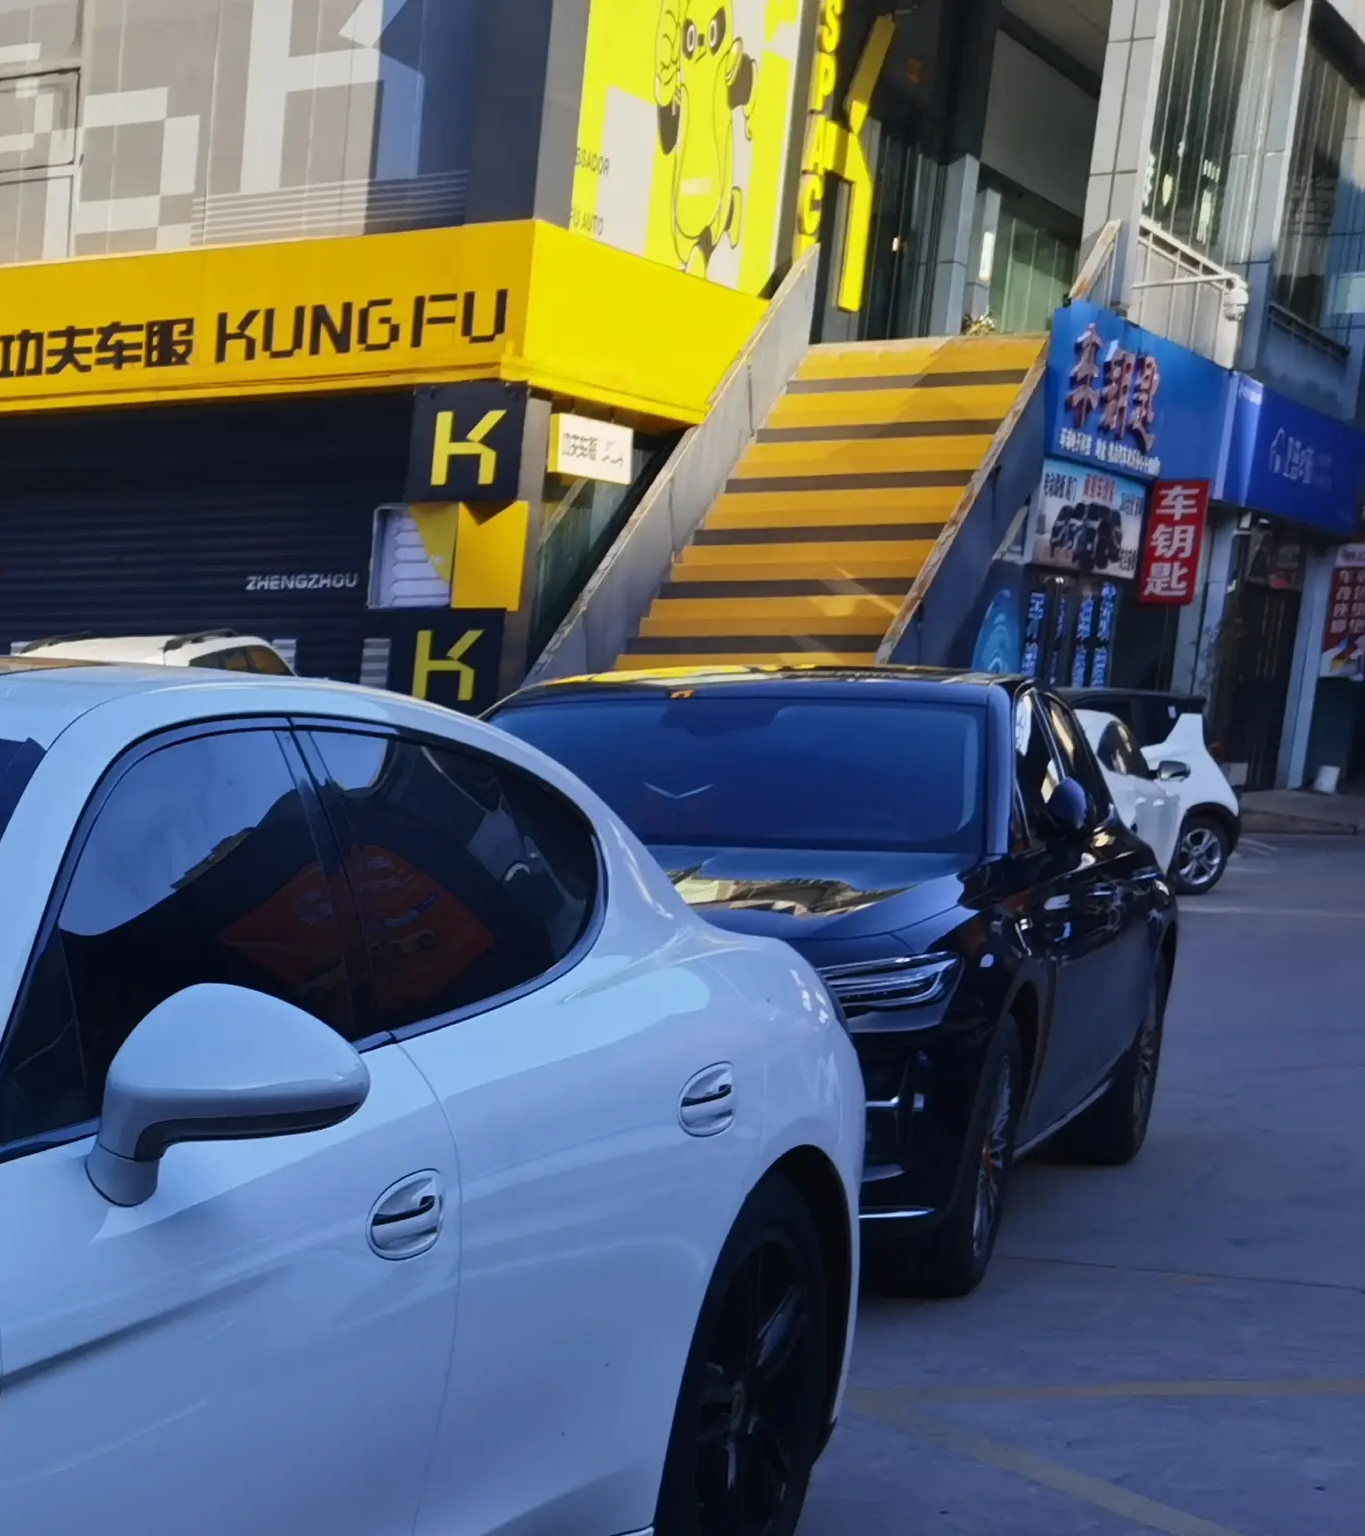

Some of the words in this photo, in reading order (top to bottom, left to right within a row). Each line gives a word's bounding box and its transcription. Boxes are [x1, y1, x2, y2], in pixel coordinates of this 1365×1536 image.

[215, 299, 399, 364] KUNG
[410, 289, 508, 348] FU
[1143, 485, 1200, 597] 车钥匙
[245, 572, 360, 591] ZHENGZHOU
